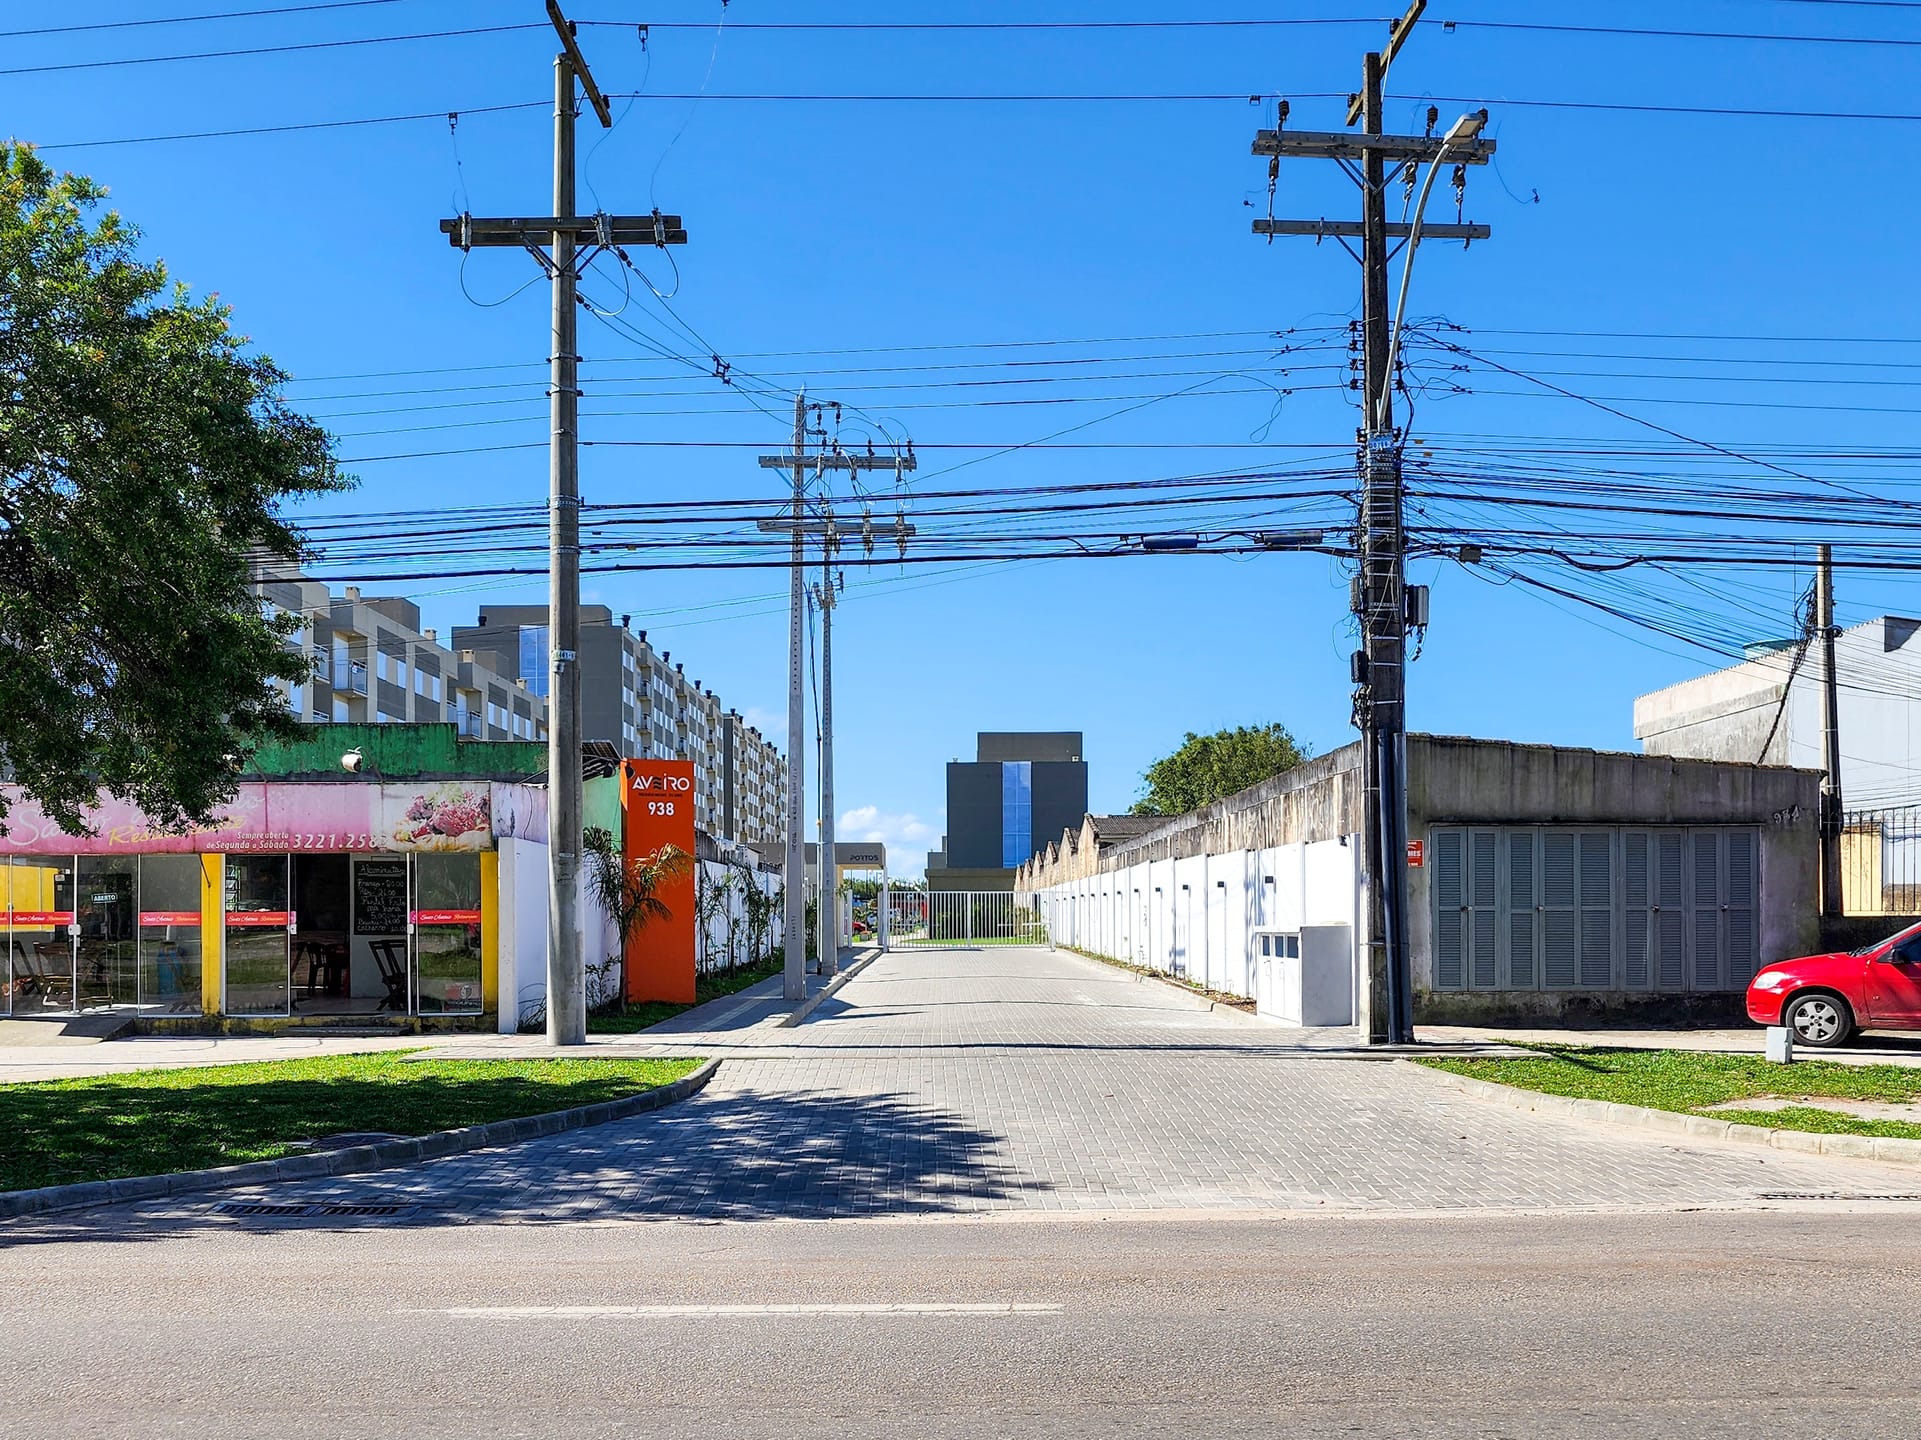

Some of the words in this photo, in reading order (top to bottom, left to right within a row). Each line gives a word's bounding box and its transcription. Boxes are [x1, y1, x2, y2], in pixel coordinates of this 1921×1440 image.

[632, 773, 690, 790] AVEIRO
[648, 802, 674, 815] 938
[237, 831, 264, 840] Sempre
[264, 831, 289, 839] aberto
[216, 840, 250, 850] Segunda
[260, 839, 289, 849] Sábado
